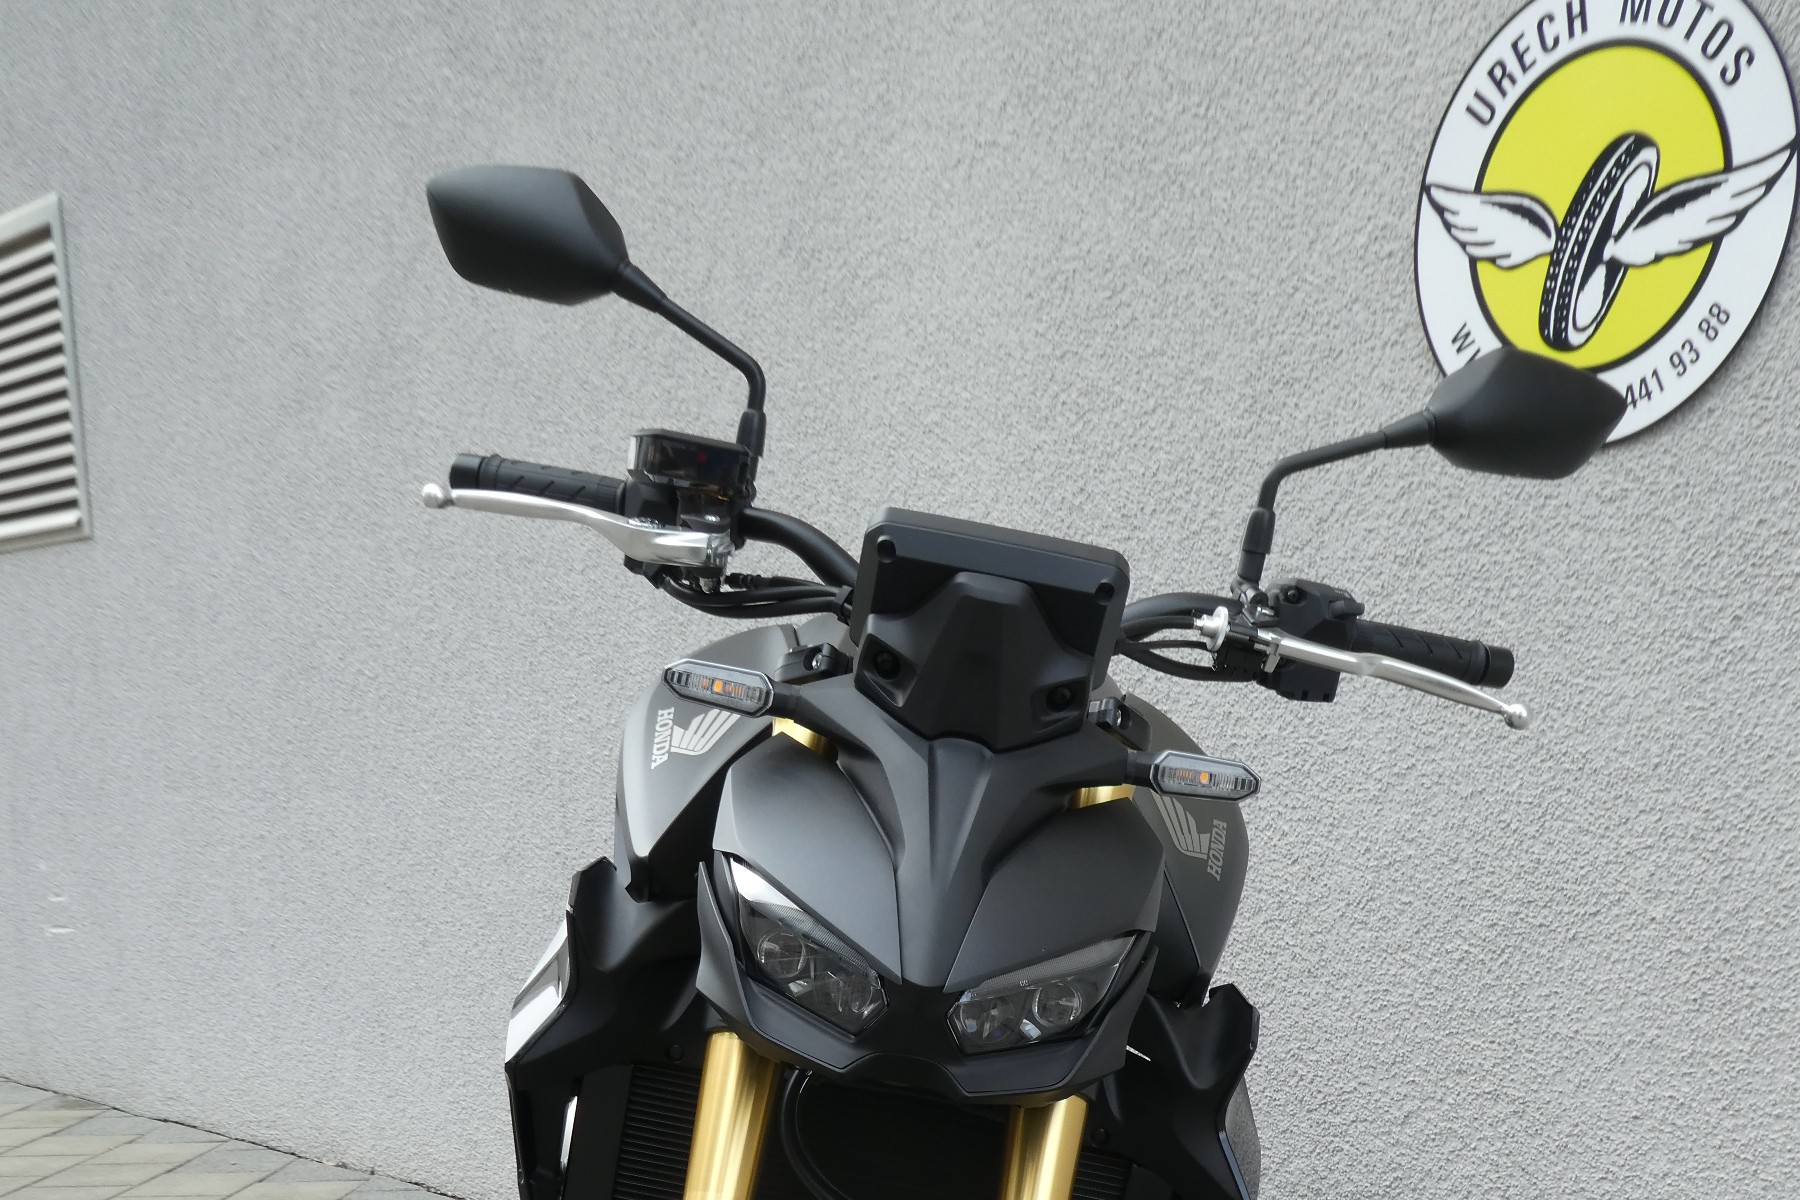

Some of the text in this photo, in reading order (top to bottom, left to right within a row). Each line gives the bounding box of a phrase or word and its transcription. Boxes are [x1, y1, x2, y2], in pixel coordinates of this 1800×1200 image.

[1465, 0, 1756, 126] URECH MOTOS
[1624, 302, 1730, 409] 441 93 88
[651, 707, 675, 770] HONDA
[1207, 819, 1228, 882] HONDA
